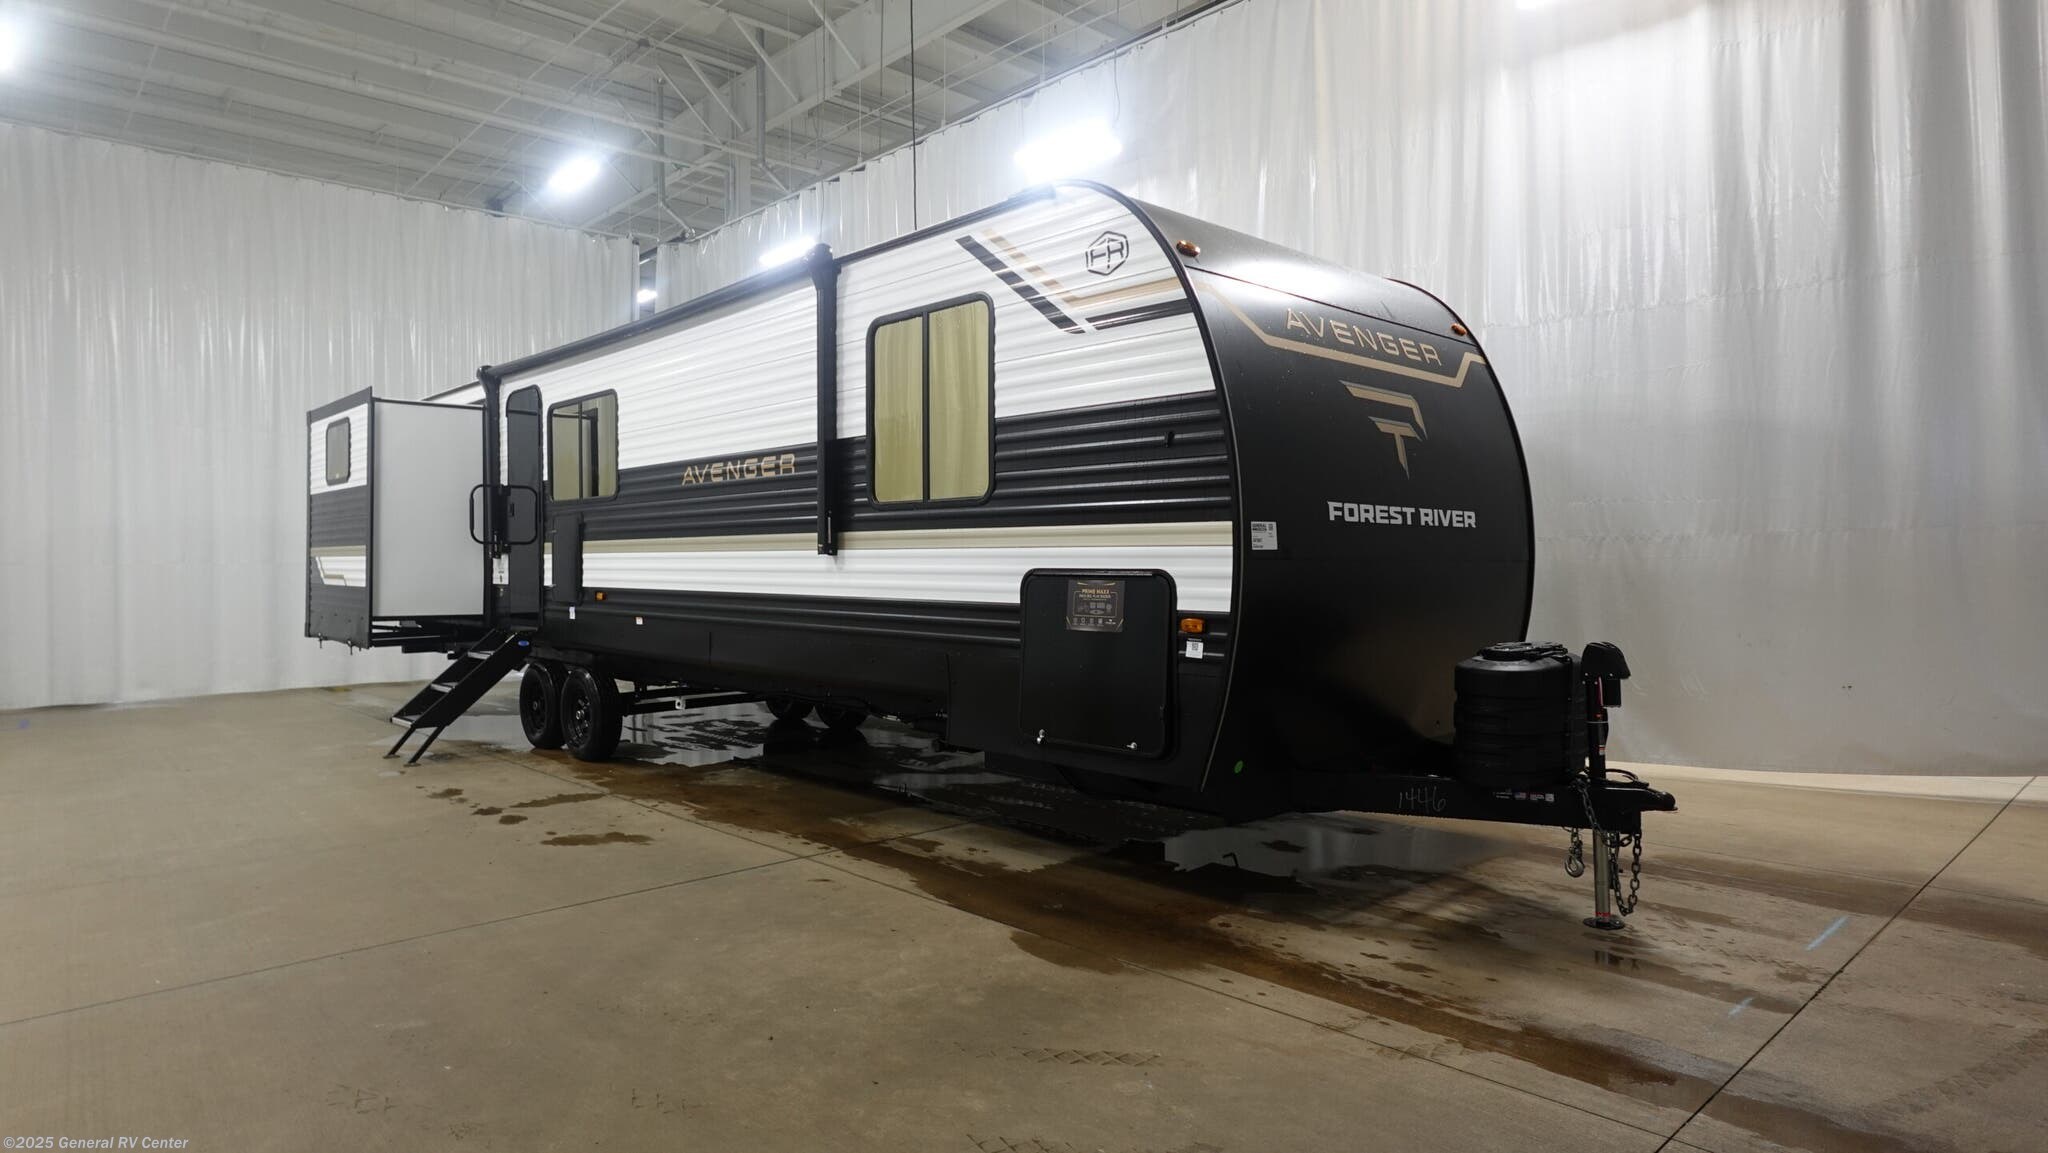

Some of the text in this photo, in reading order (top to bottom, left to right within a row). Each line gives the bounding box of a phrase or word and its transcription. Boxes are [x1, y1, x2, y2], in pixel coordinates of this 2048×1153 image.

[1286, 308, 1442, 366] AVENGER
[681, 453, 795, 486] AVENGER
[1327, 501, 1477, 529] FOREST RIVER
[1398, 785, 1447, 813] 1446
